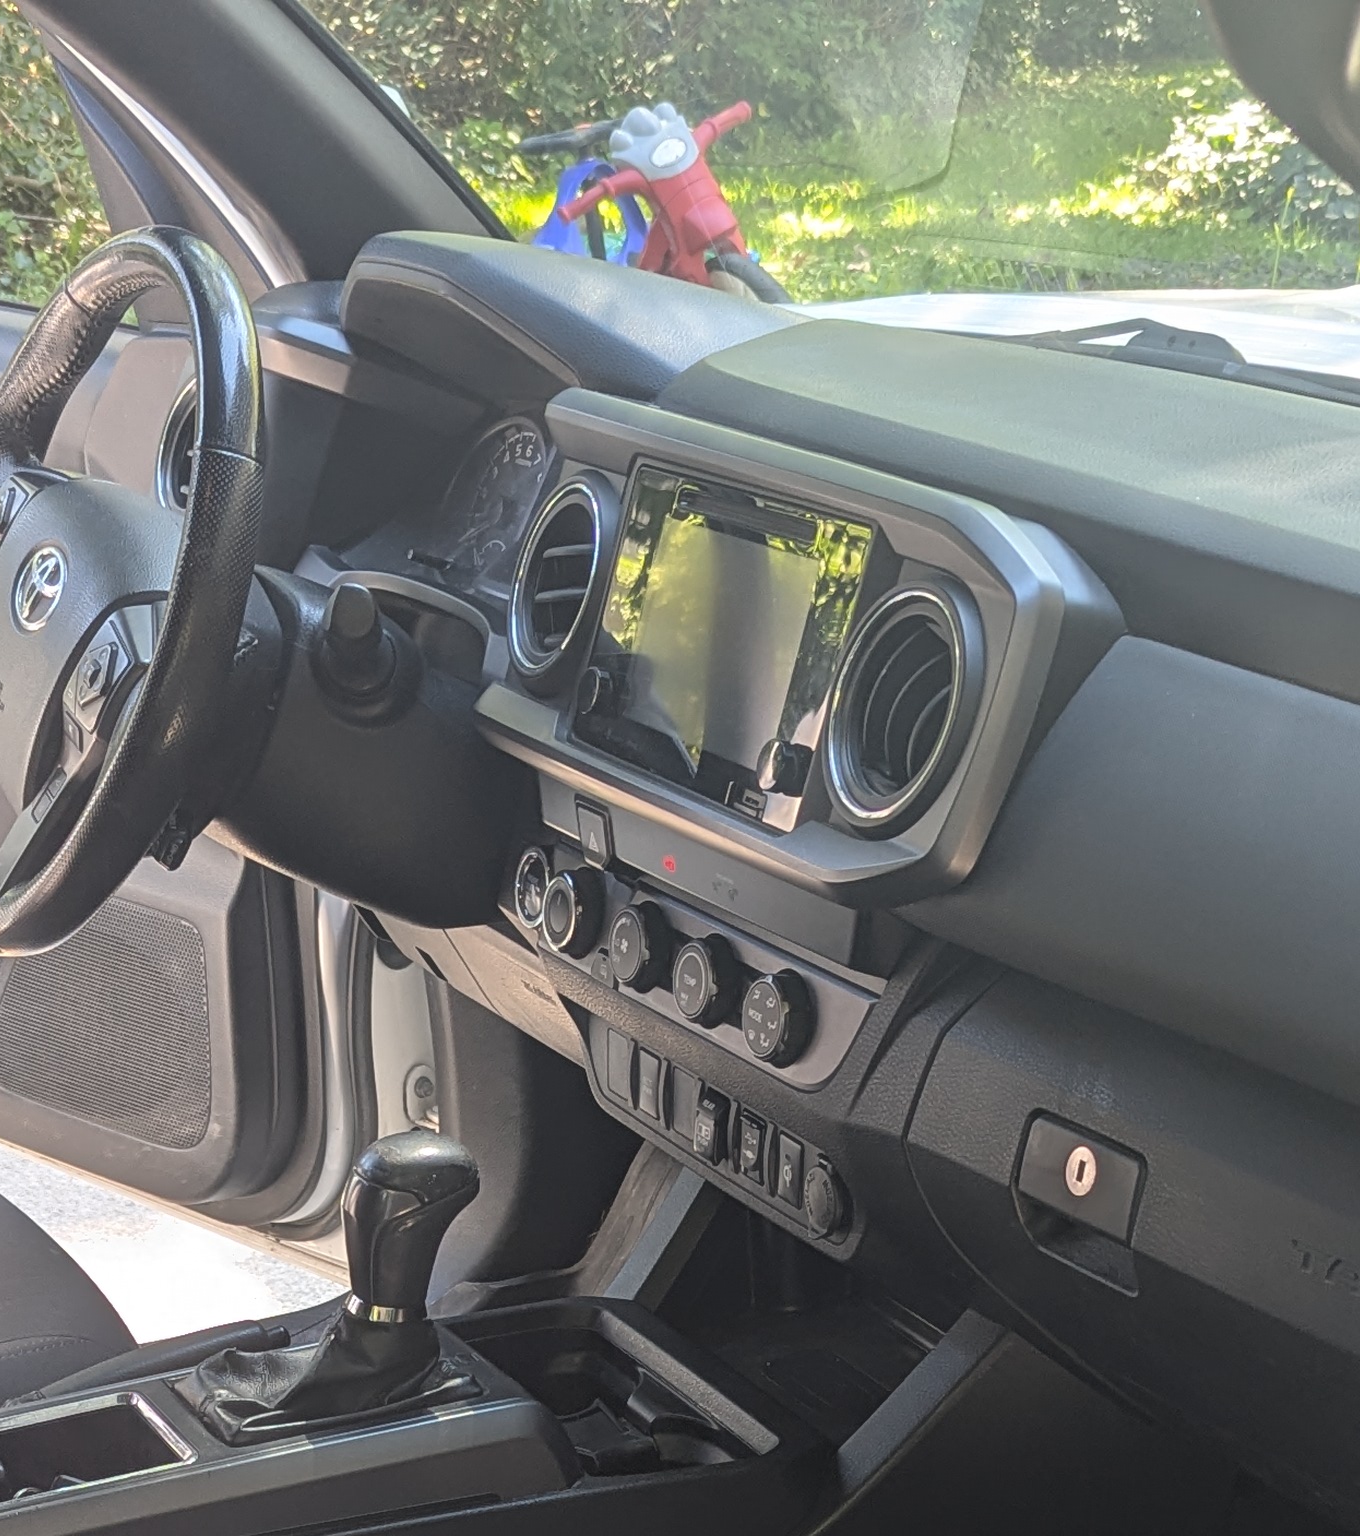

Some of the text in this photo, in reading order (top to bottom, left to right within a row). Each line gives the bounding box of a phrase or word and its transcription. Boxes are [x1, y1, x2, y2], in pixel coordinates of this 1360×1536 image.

[515, 443, 523, 457] 5
[525, 445, 534, 458] 6
[747, 1007, 763, 1024] MODE
